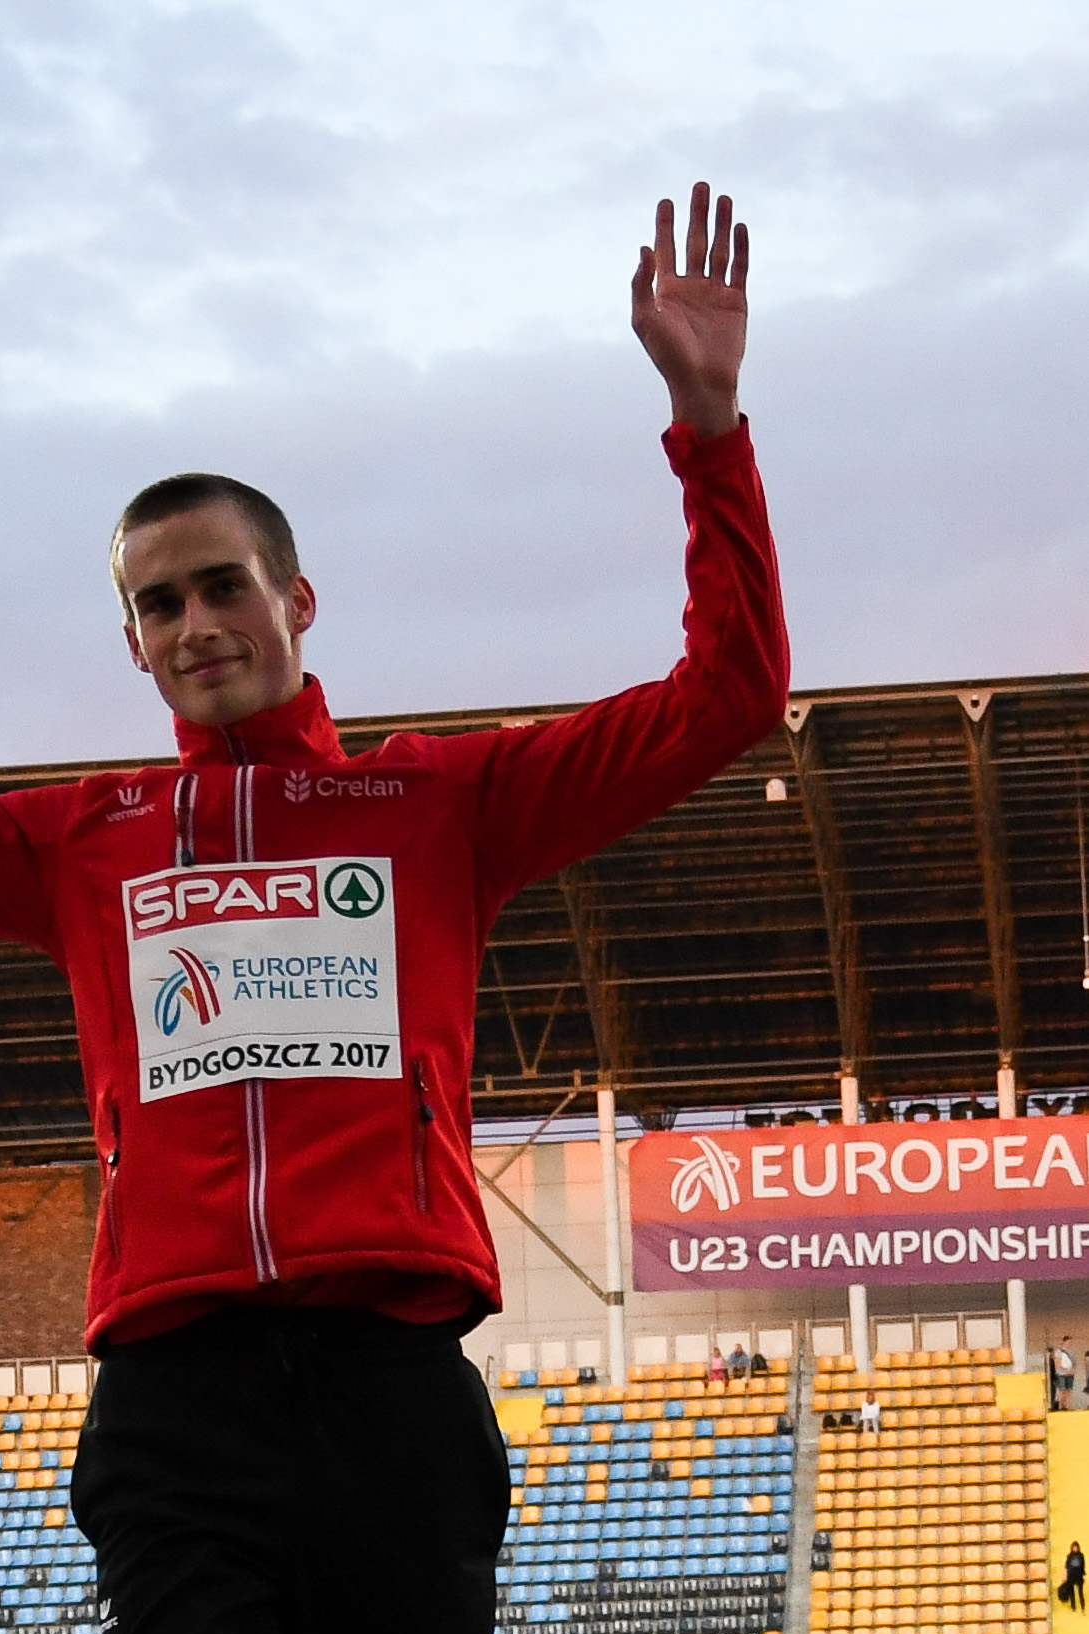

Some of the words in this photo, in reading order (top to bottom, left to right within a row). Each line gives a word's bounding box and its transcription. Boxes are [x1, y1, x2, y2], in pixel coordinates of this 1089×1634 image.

[316, 775, 403, 797] Crelan
[133, 873, 313, 929] SPAR
[232, 956, 378, 978] EUROPEAN
[232, 979, 378, 1000] ATHLETICS
[149, 1042, 321, 1089] BYDGOSZCZ
[330, 1042, 391, 1069] 2017
[751, 1133, 1089, 1199] EUROPEA
[669, 1235, 749, 1273] U23
[759, 1223, 1089, 1270] CHAMPIONSHIP
